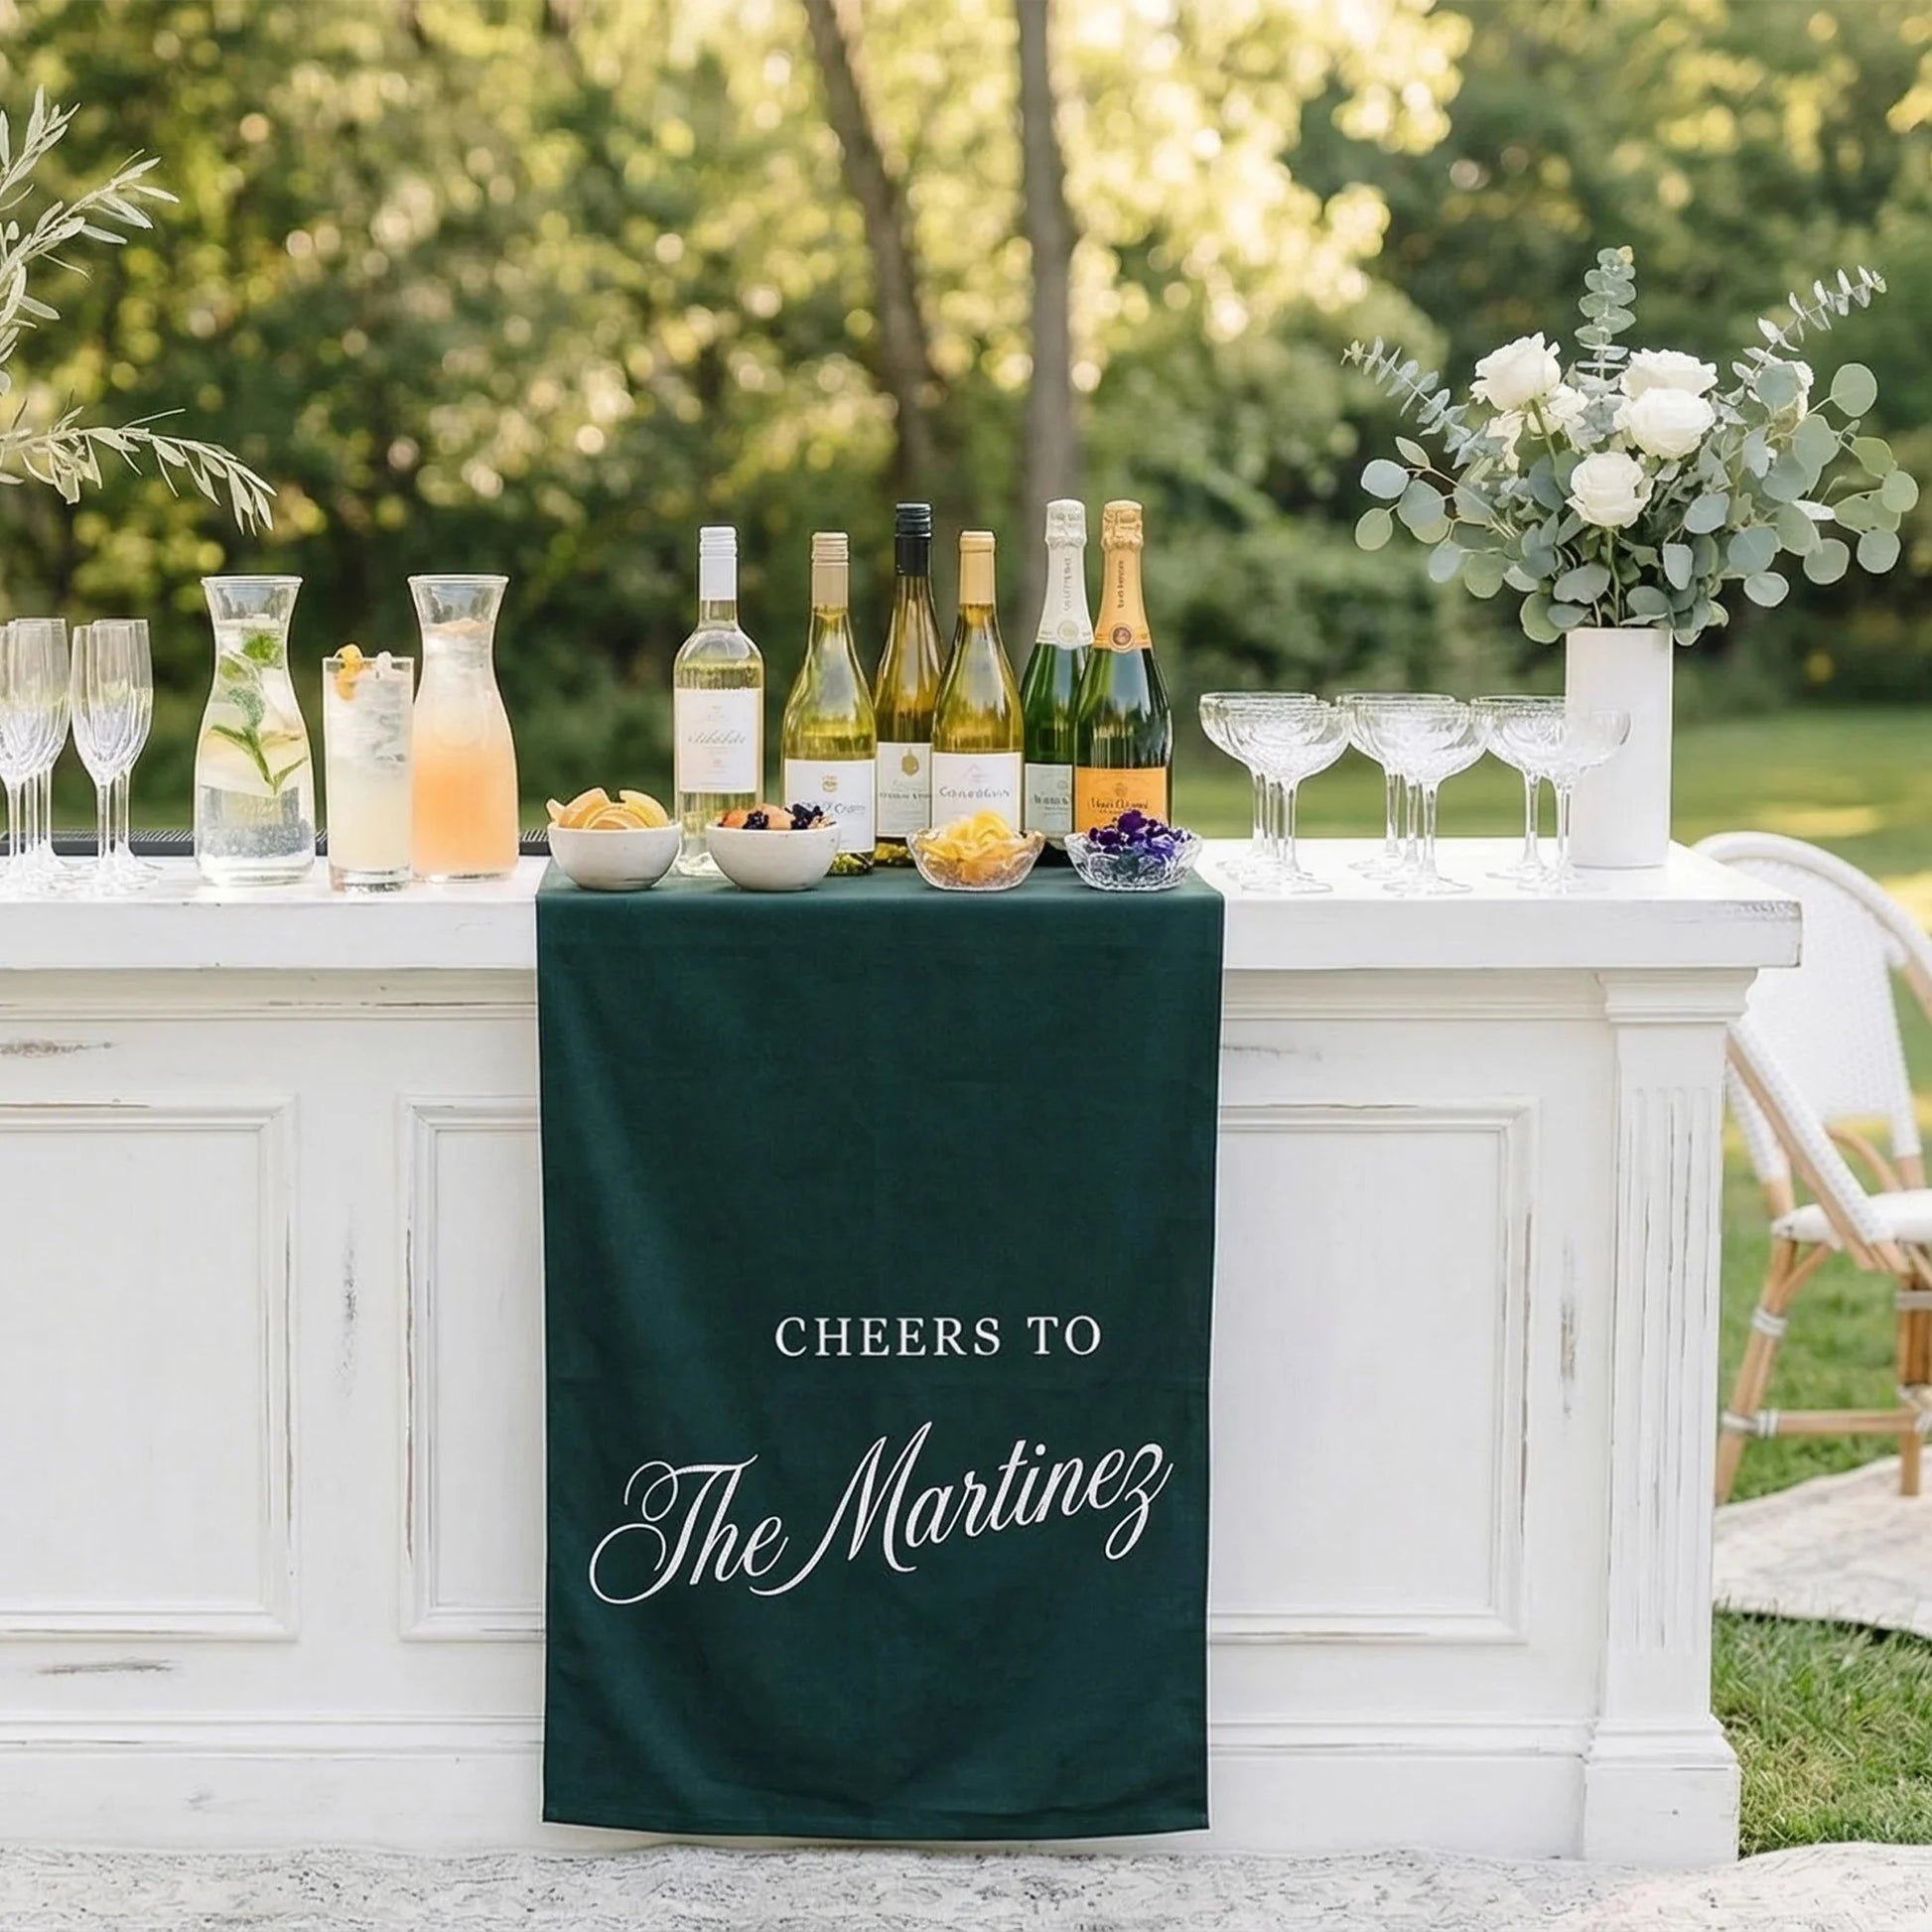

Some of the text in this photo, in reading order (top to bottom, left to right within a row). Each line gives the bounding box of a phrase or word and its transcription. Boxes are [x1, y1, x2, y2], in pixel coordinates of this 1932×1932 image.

[775, 1314, 1101, 1357] CHEERS TO
[589, 1421, 1174, 1604] The Martinez
